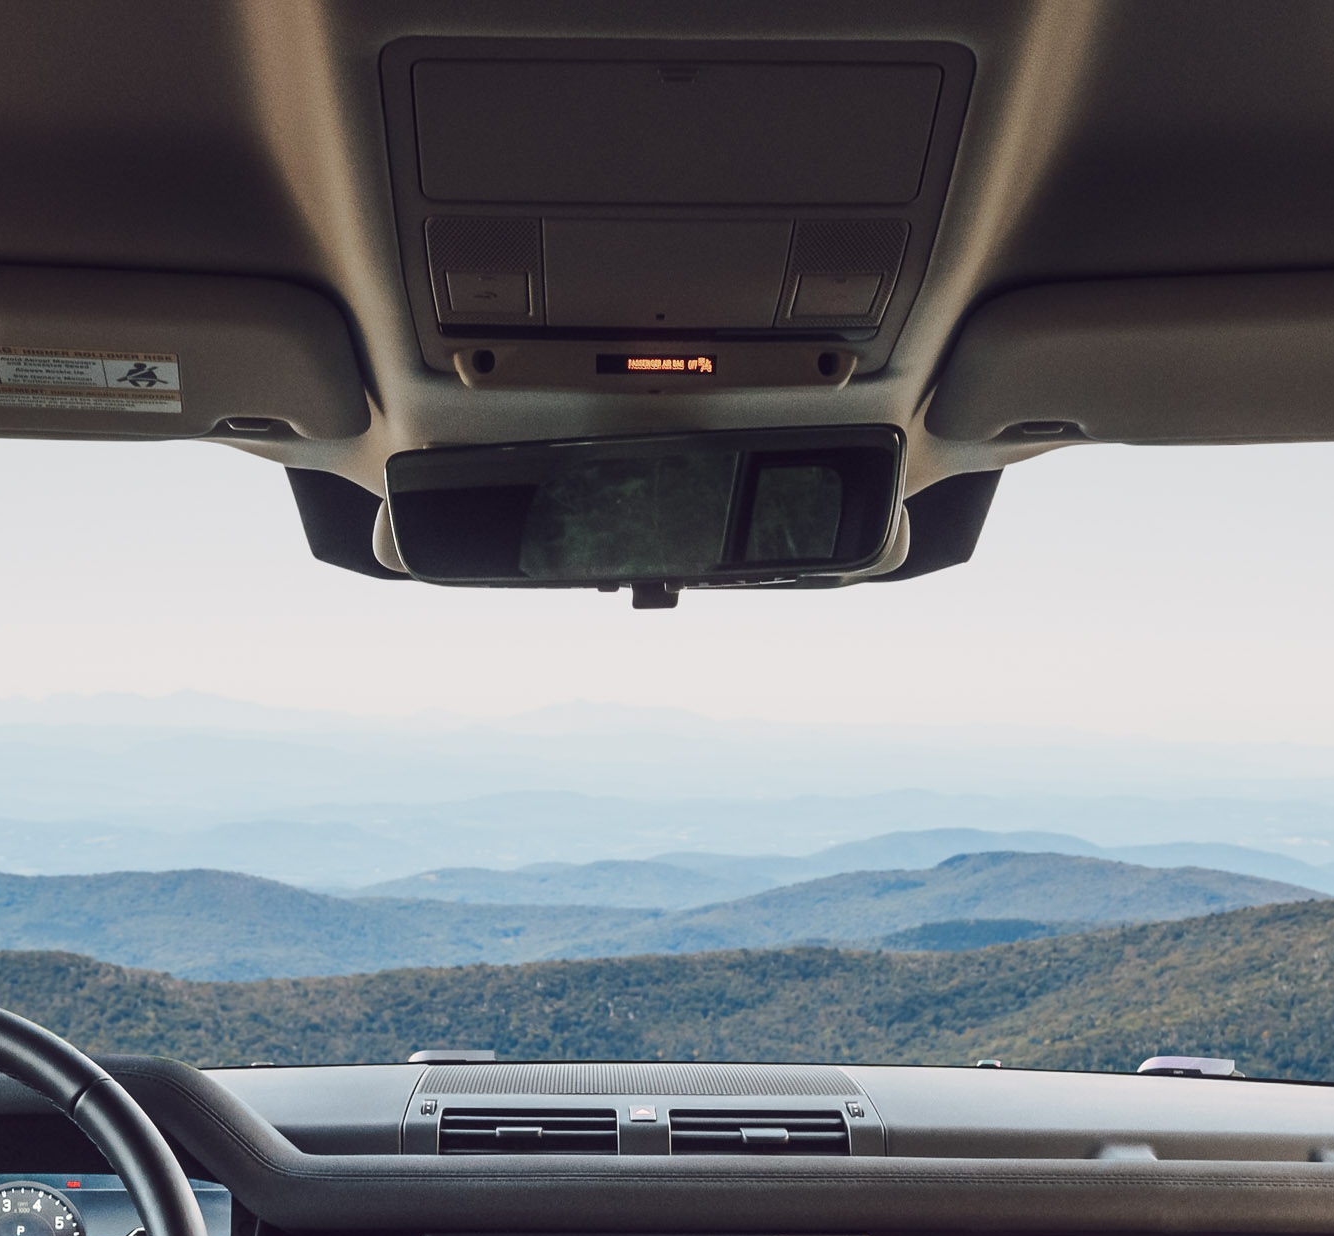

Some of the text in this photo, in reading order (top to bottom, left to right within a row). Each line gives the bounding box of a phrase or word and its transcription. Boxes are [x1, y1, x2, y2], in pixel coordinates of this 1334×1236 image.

[2, 1199, 12, 1212] 3
[33, 1199, 42, 1212] 4
[55, 1216, 65, 1230] 5
[17, 1225, 25, 1236] P
